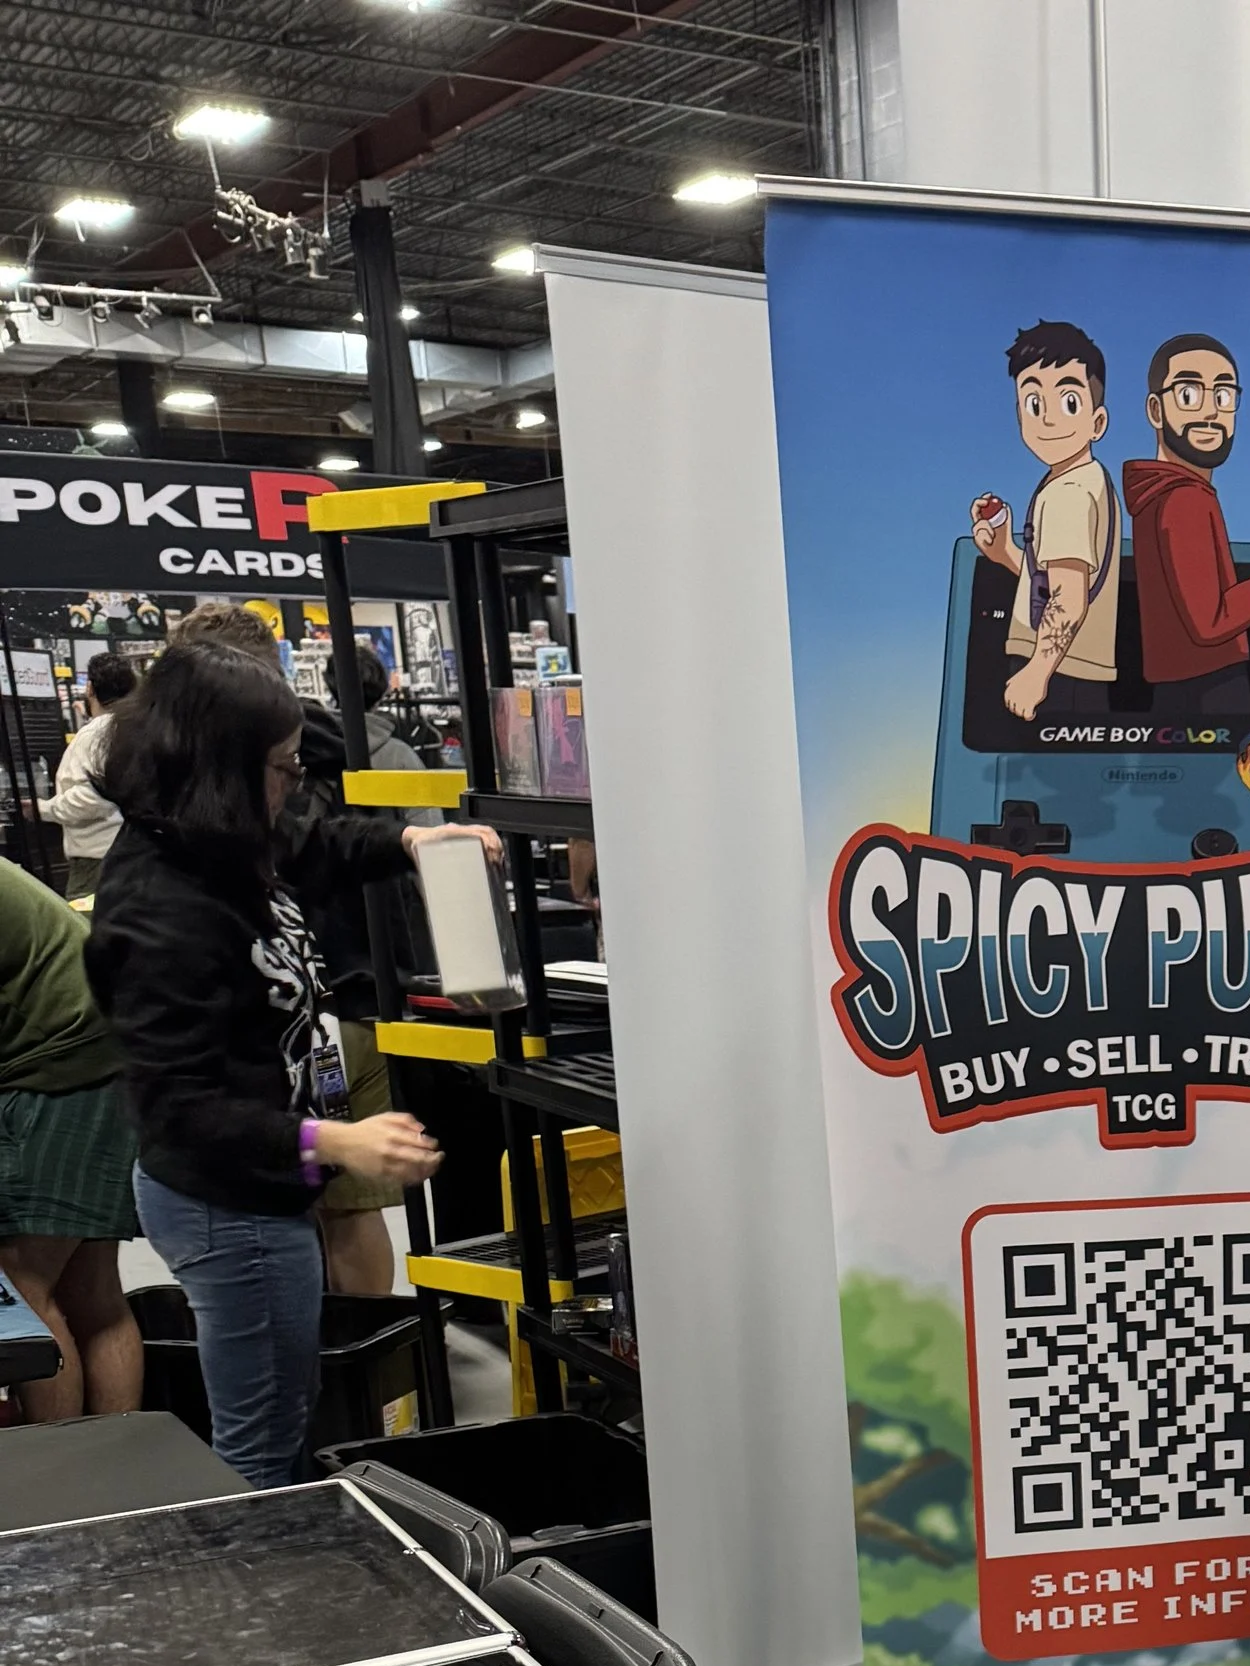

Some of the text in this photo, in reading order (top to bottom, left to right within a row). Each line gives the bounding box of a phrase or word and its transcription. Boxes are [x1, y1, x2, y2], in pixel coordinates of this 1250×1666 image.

[159, 548, 325, 579] CARDS
[1039, 727, 1231, 745] GAME BOY COLOR
[1107, 767, 1179, 782] Nintendo
[850, 845, 1125, 1050] SPICY
[940, 1046, 1031, 1104] BUY
[1067, 1034, 1173, 1079] SELL
[1112, 1094, 1176, 1122] TCG
[1030, 1566, 1154, 1598] SCAN
[1016, 1601, 1139, 1634] MORE
